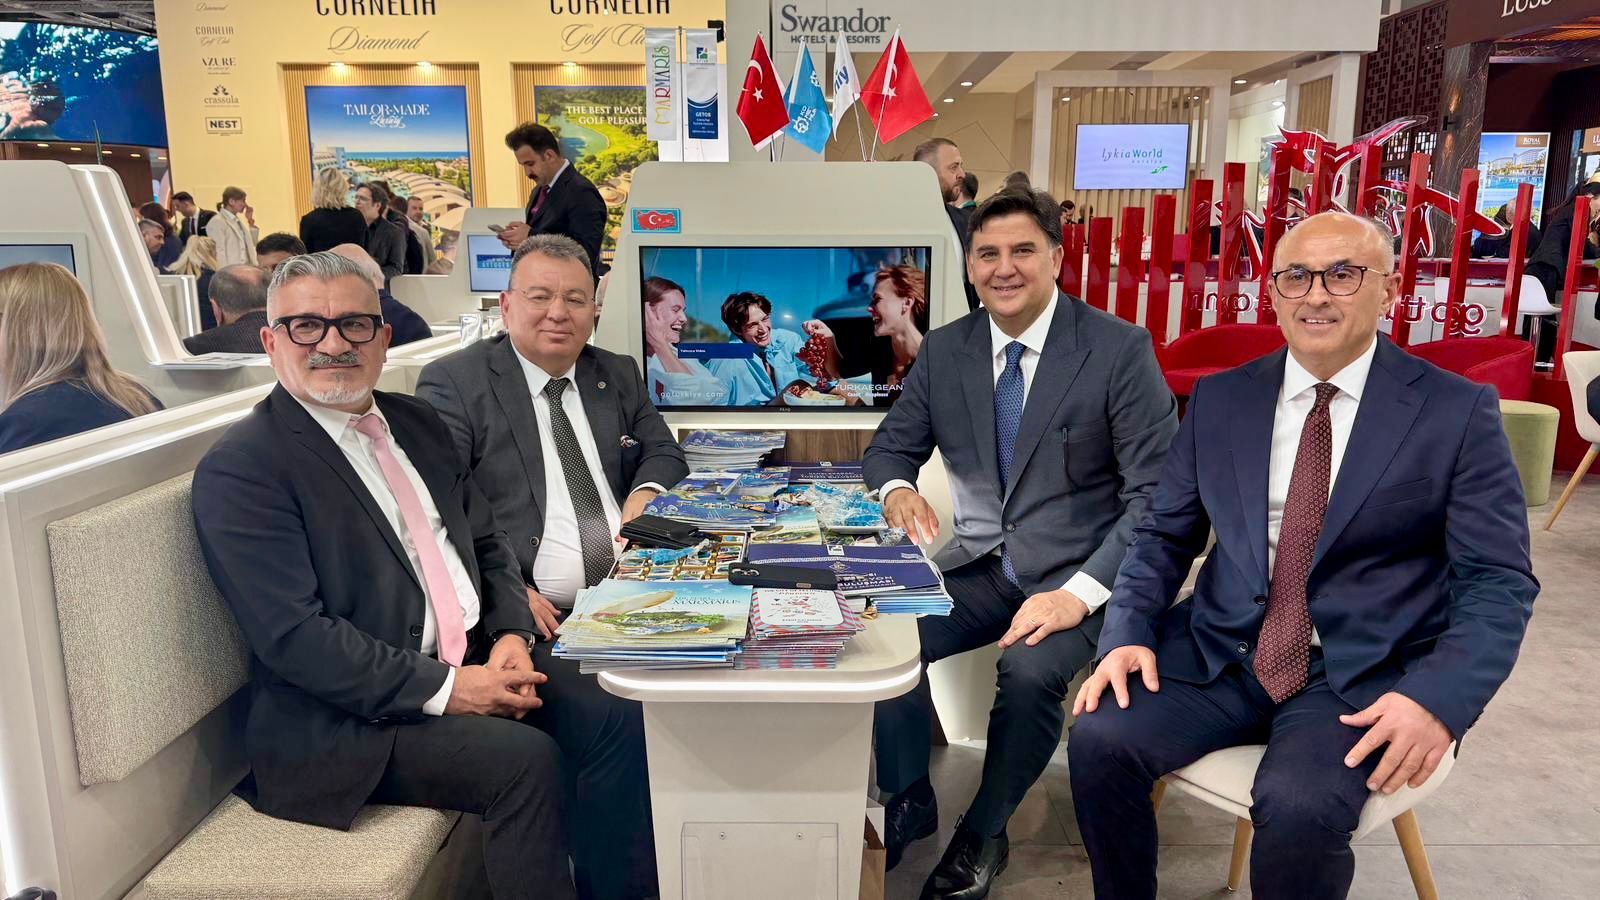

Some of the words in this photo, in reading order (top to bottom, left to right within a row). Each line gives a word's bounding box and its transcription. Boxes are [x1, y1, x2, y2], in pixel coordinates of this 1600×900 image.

[780, 4, 892, 33] Swandor
[195, 26, 235, 35] CORNELIA
[327, 25, 430, 55] Diamond
[561, 23, 614, 54] Golf
[611, 23, 646, 47] Clu
[846, 35, 881, 44] ESORTS
[202, 57, 237, 67] AZURE
[204, 95, 240, 104] crassula
[566, 105, 587, 115] THE
[588, 105, 612, 115] BEST
[613, 105, 644, 115] PLACE
[209, 119, 239, 129] NEST
[578, 116, 606, 125] GOLF
[607, 116, 648, 125] PLEASUR
